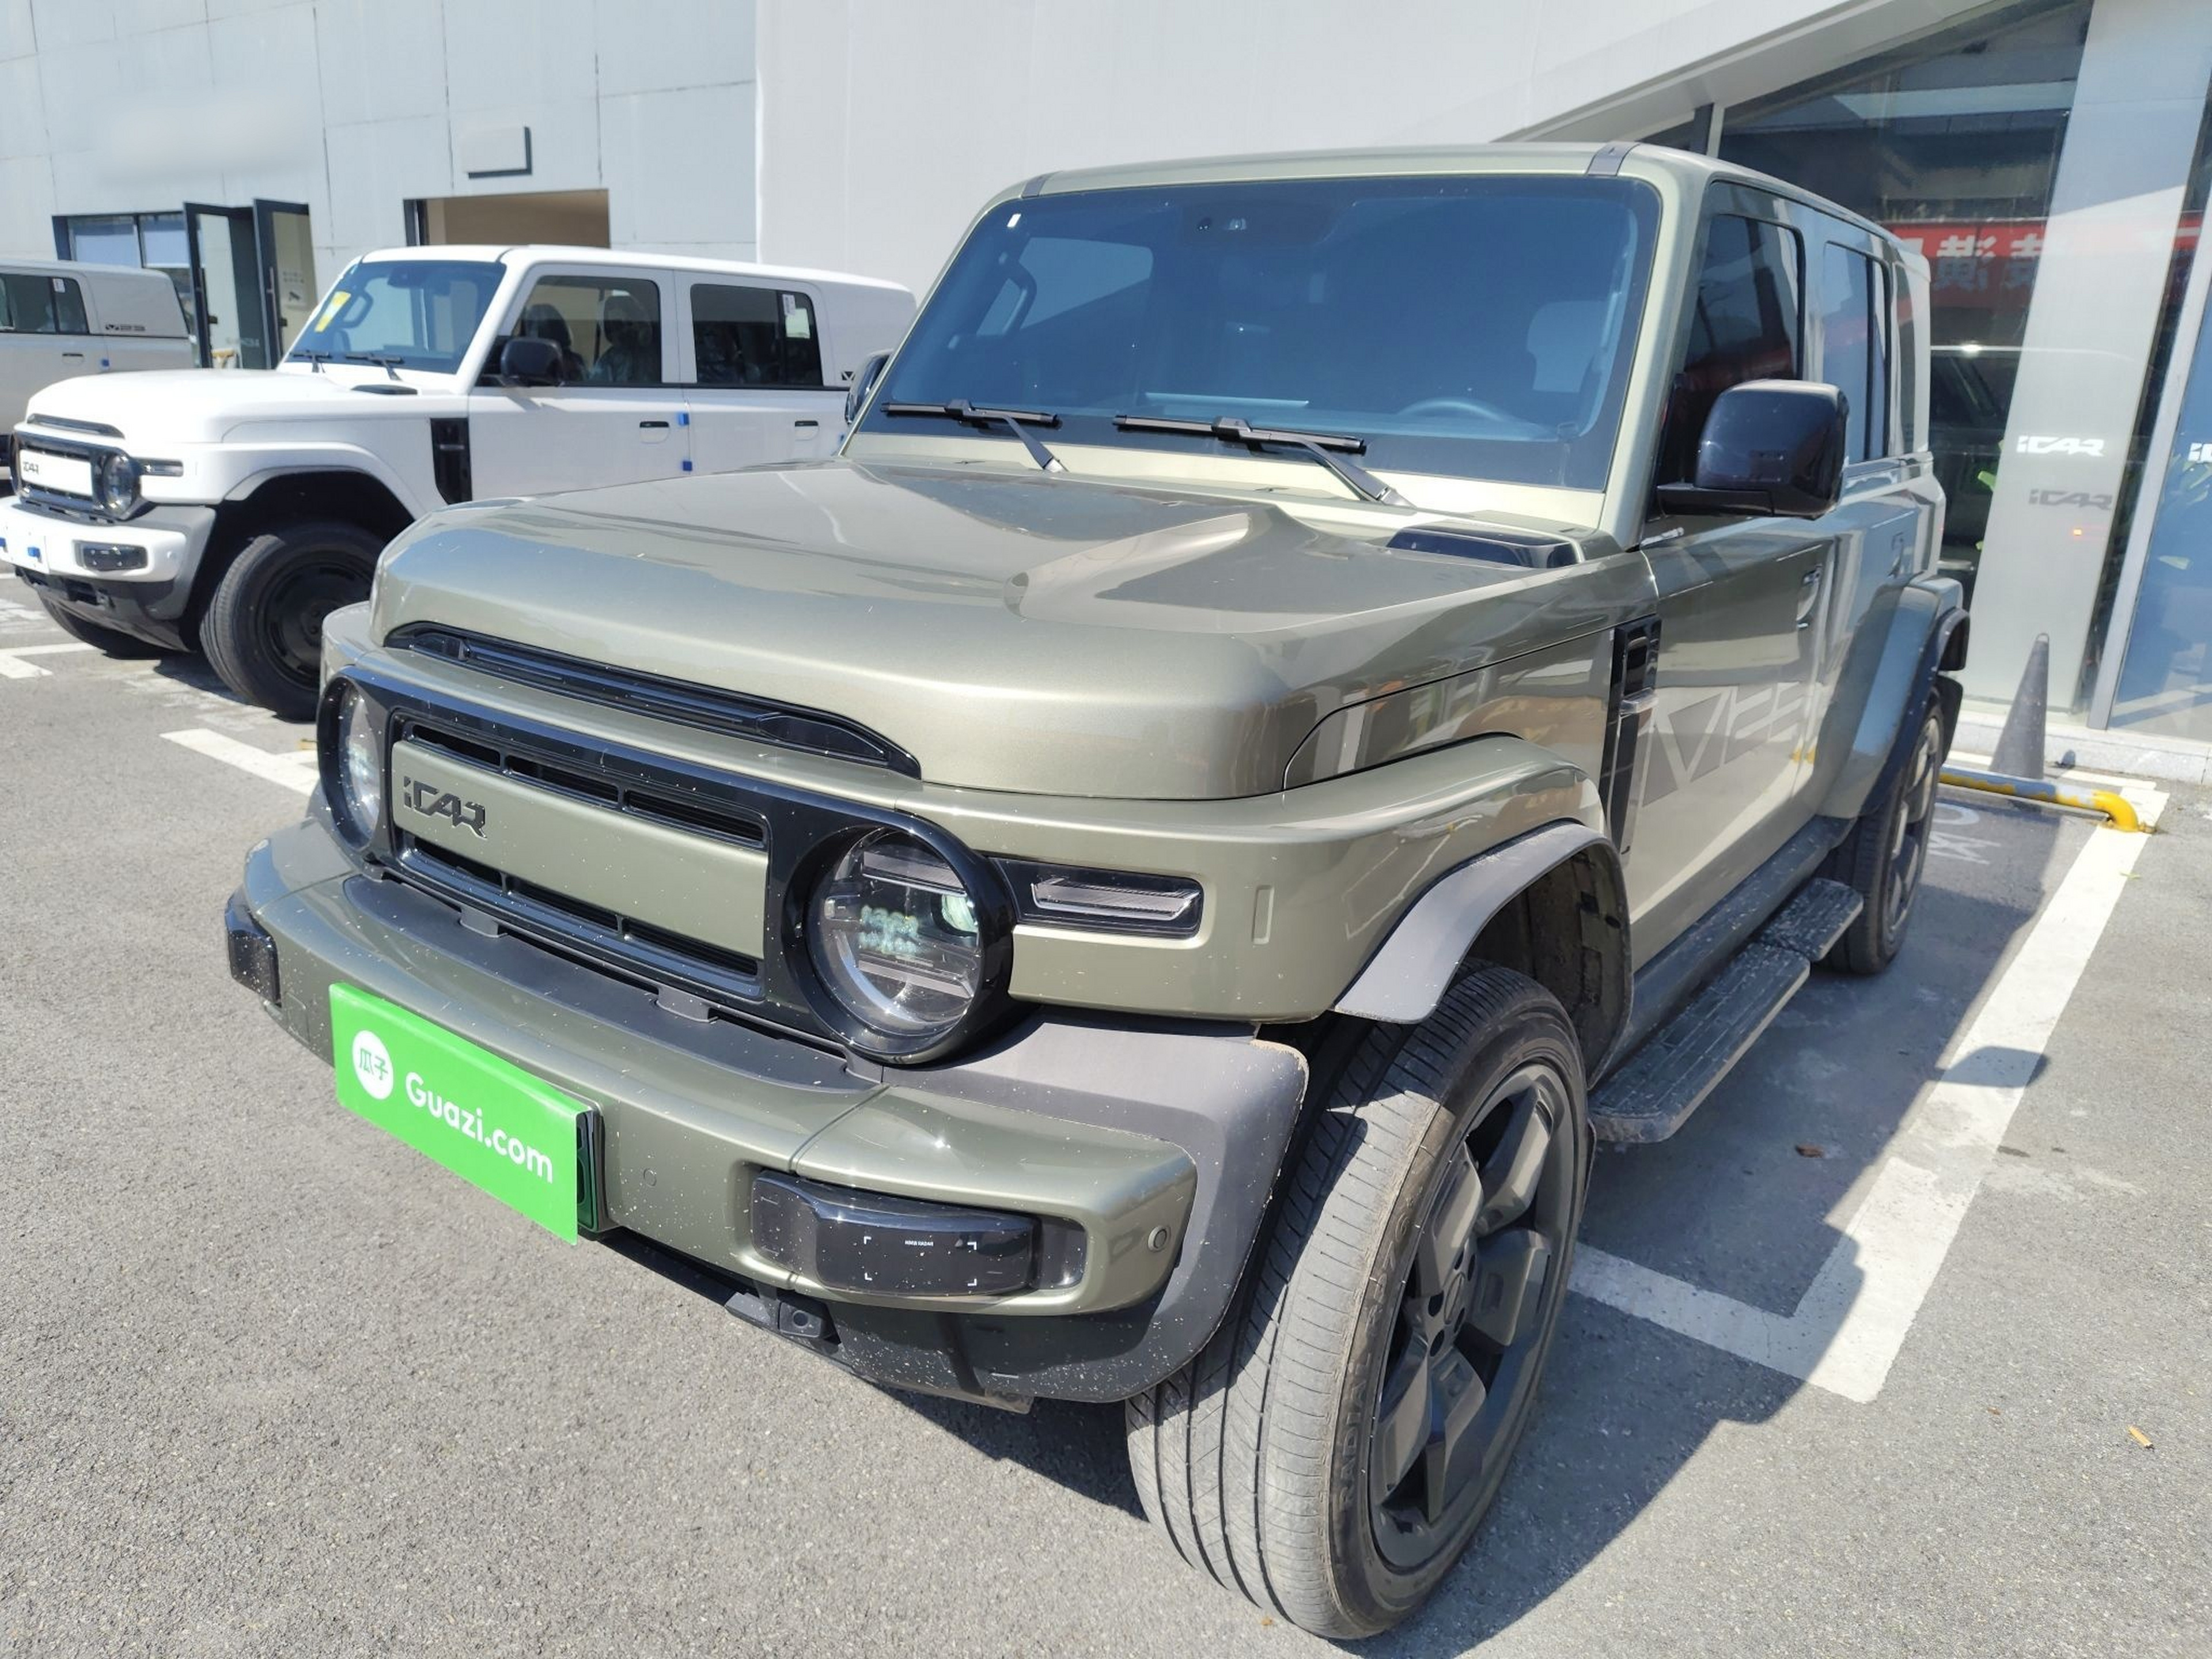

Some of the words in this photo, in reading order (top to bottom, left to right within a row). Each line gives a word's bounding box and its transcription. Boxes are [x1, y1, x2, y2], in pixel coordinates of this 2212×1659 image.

[403, 776, 487, 839] iCAR
[359, 1048, 388, 1081] 瓜子
[406, 1072, 553, 1184] Guazi.com
